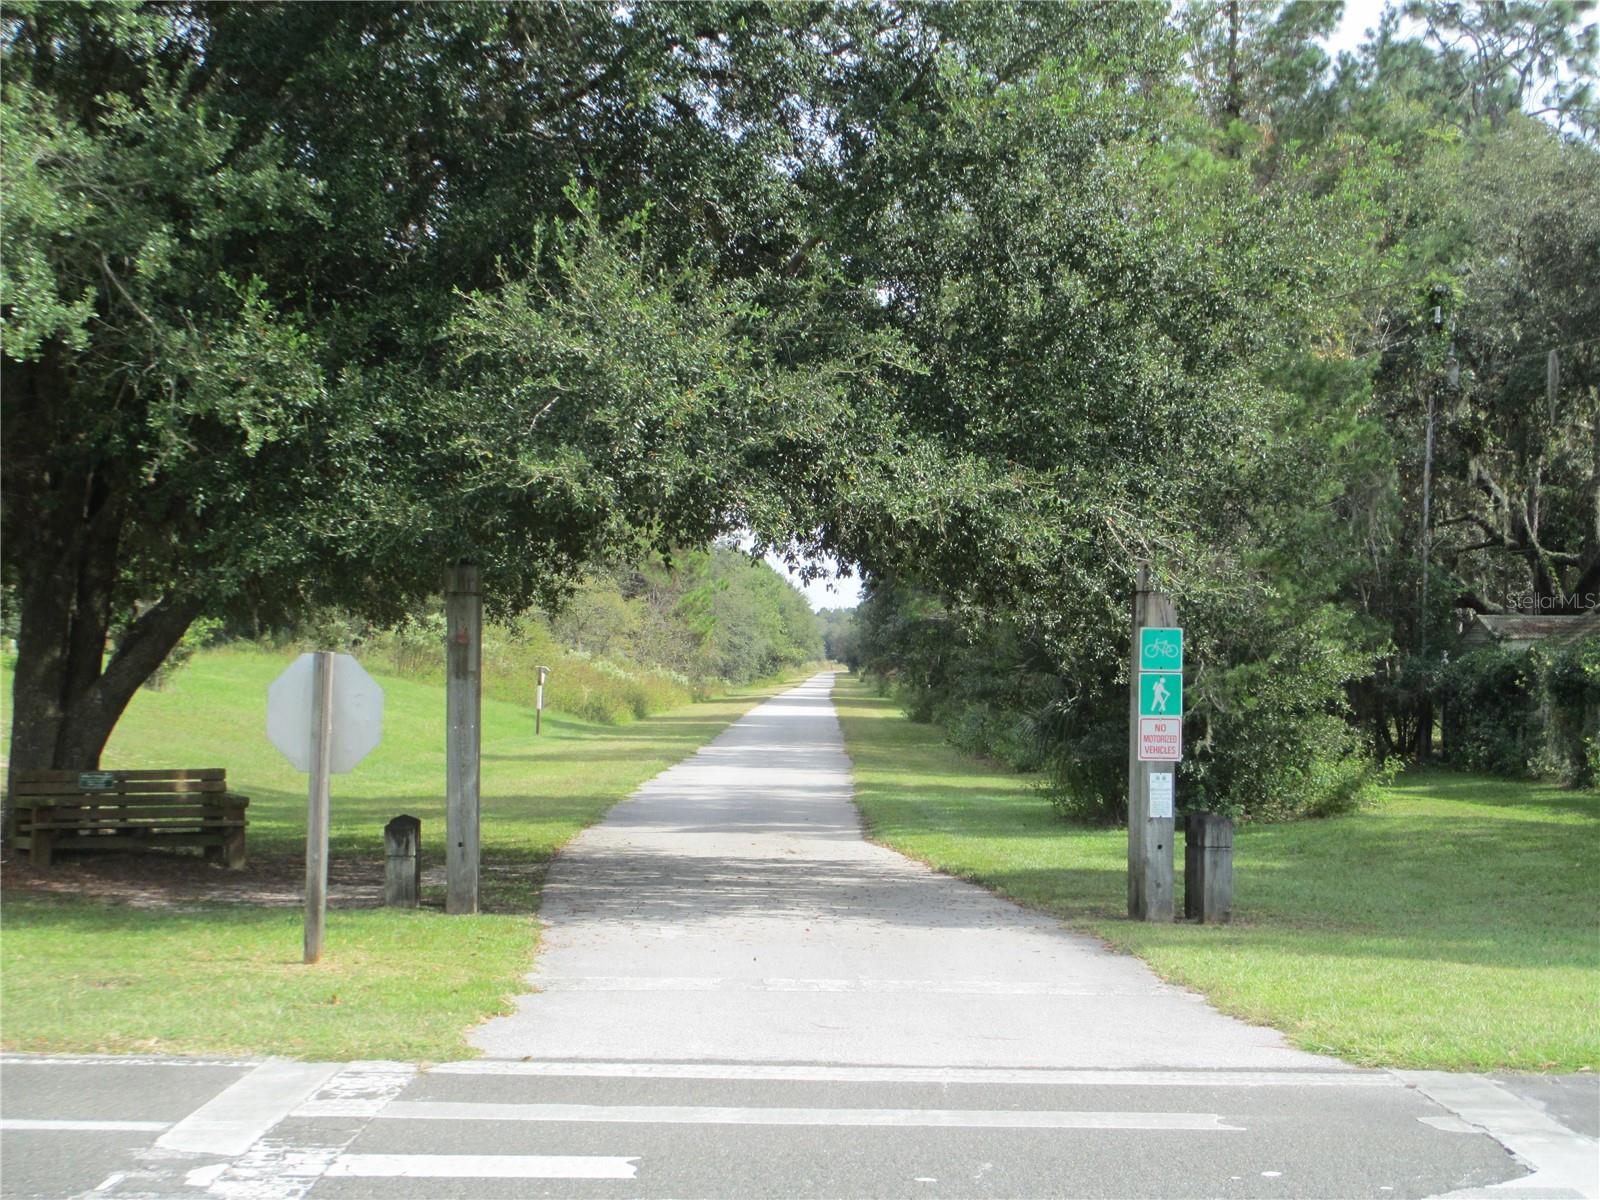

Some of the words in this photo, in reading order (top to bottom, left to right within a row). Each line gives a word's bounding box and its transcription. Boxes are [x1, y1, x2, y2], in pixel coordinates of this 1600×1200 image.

[1154, 723, 1167, 732] NO
[1143, 734, 1178, 744] MOTORIZED
[1144, 745, 1176, 755] VEHICLES
